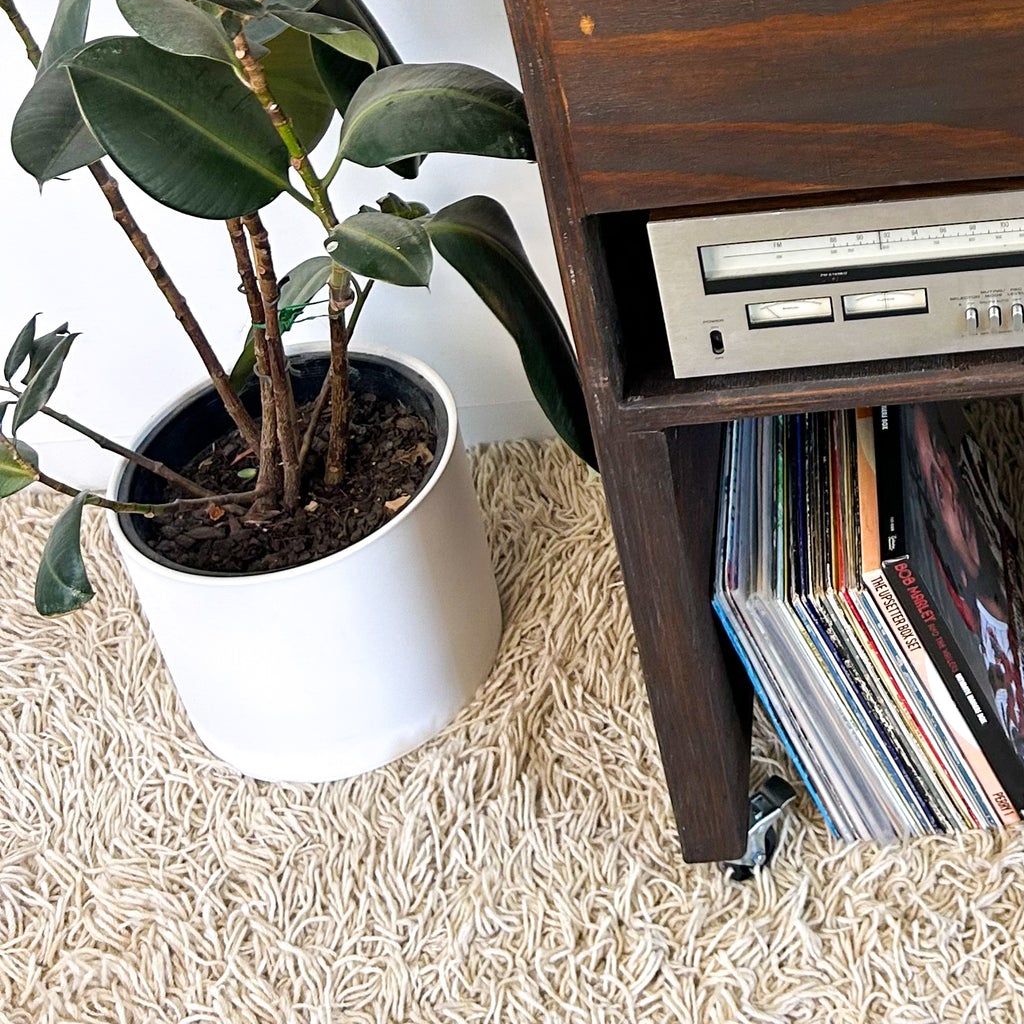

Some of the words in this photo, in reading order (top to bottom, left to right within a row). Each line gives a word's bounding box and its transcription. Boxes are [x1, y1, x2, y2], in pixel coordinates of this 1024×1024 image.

[871, 574, 888, 592] THE
[894, 562, 916, 586] BOB
[907, 585, 937, 623] MARLEY
[878, 587, 906, 626] UPSETTER
[897, 622, 913, 641] BOX
[905, 636, 922, 652] SET
